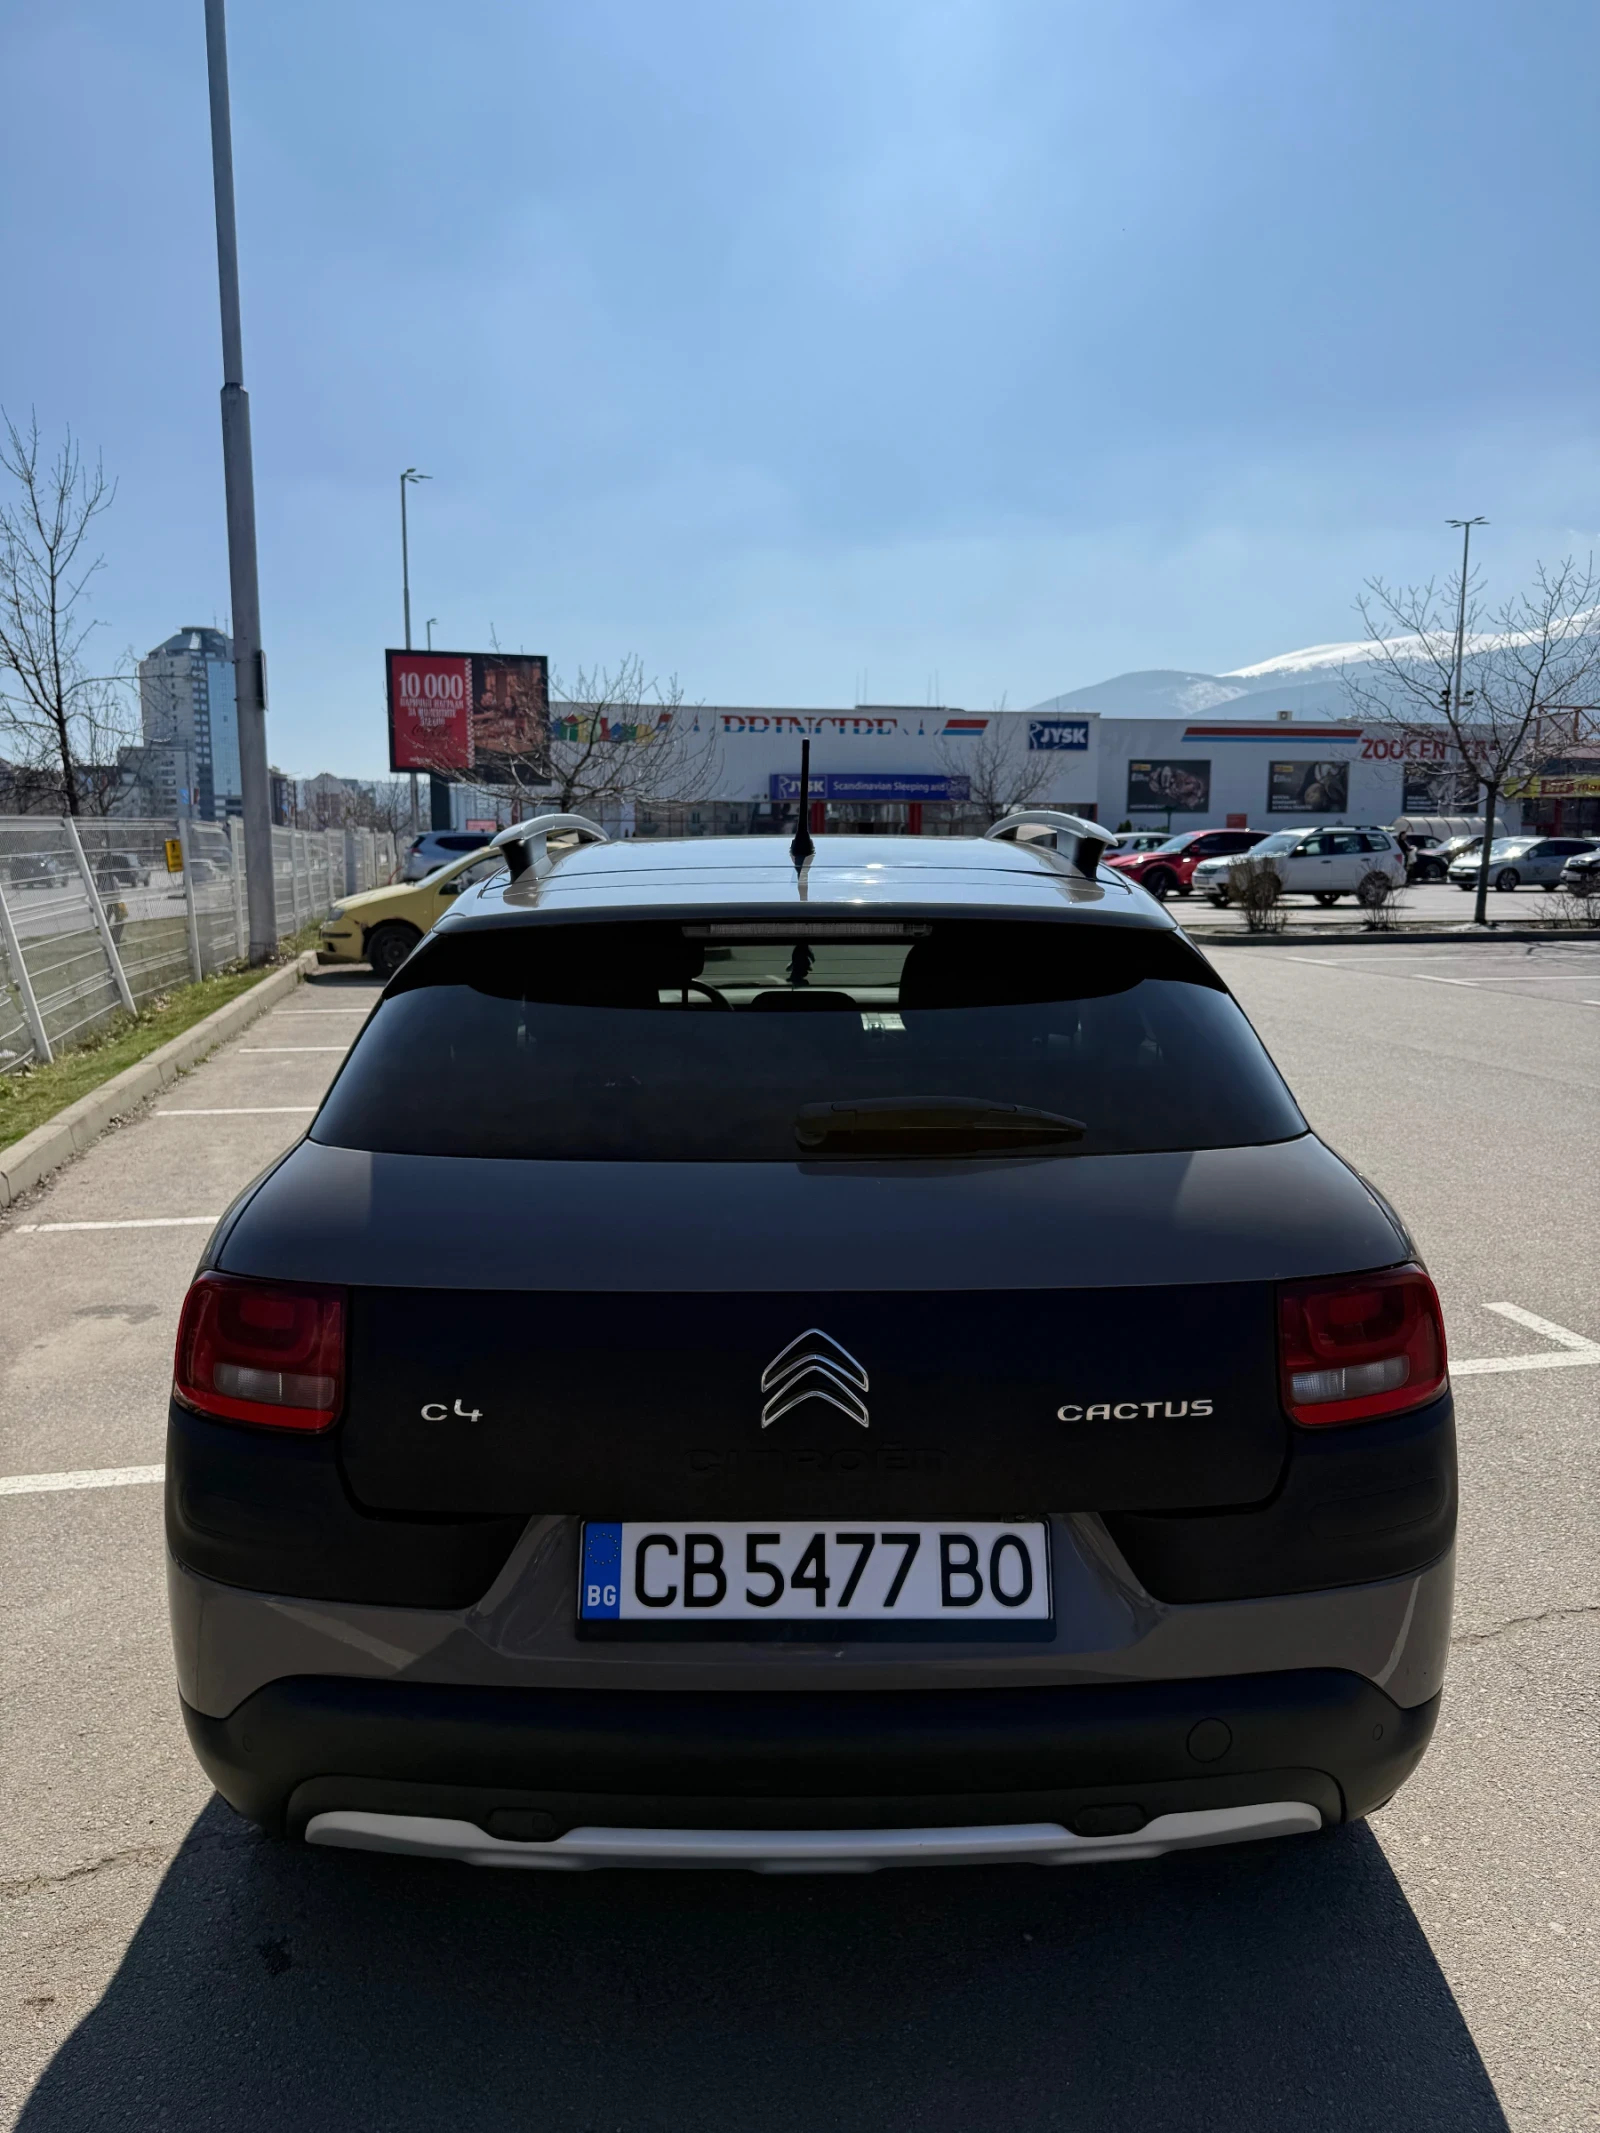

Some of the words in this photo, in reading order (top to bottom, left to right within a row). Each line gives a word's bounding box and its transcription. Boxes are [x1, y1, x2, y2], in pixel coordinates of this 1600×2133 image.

[399, 672, 420, 698] 10
[424, 673, 464, 699] 000
[1040, 727, 1087, 744] JYSK
[1361, 738, 1488, 760] ZOOCENER
[833, 781, 892, 791] Scandinavian
[894, 782, 929, 793] Sleeping
[421, 1399, 483, 1422] C4
[1057, 1399, 1213, 1422] CACTUS
[635, 1533, 727, 1608] CB
[746, 1533, 920, 1608] 5477
[940, 1534, 1033, 1608] BO
[587, 1585, 617, 1607] BG
